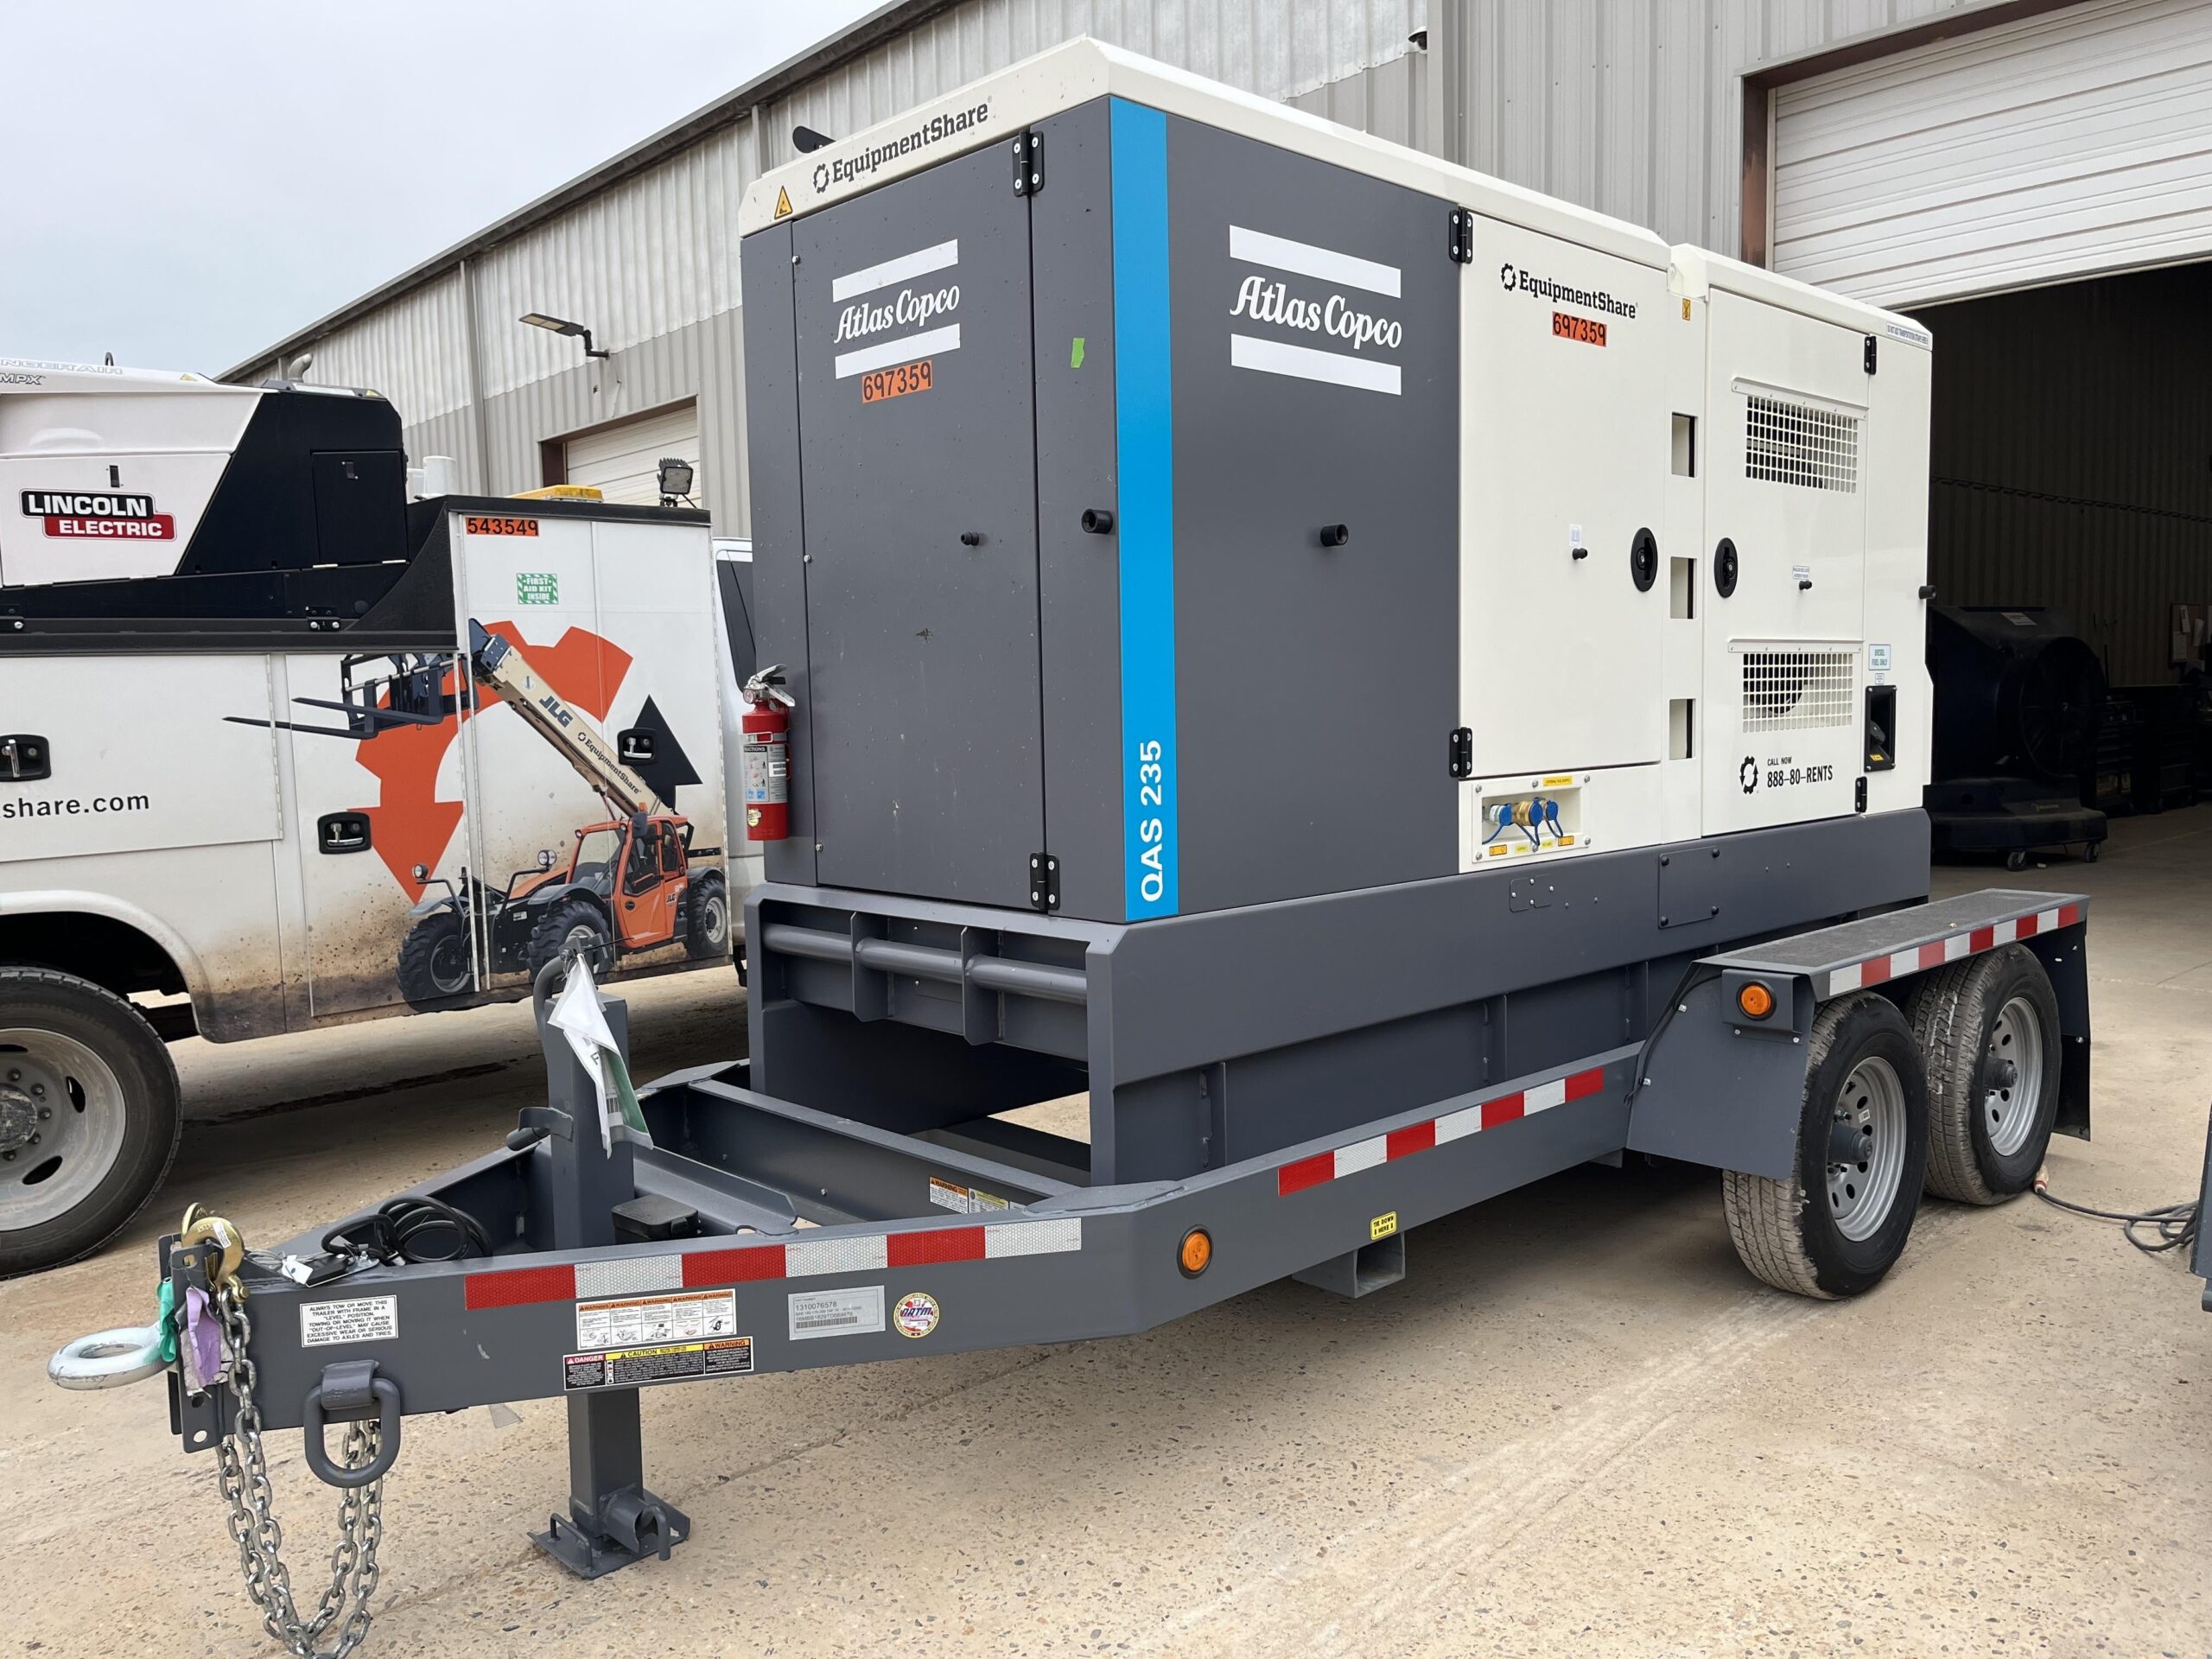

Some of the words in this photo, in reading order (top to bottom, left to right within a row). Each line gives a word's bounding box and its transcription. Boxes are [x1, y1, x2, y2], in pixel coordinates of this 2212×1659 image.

[832, 103, 988, 183] EquipmentShare
[1519, 270, 1636, 319] EquipmentShare
[834, 302, 894, 344] Atlas
[896, 285, 960, 327] Copco
[1230, 276, 1321, 332] Atlas
[1325, 295, 1402, 350] Copco
[1553, 312, 1606, 346] 697359
[863, 361, 932, 401] 697359
[28, 494, 148, 518] LINCOLN
[59, 519, 162, 537] ELECTRIC
[467, 518, 539, 536] 543549
[538, 695, 575, 728] JLG
[584, 739, 639, 795] EquipmentShare
[1140, 740, 1162, 806] 235
[1767, 758, 1779, 766] CALL
[1781, 756, 1792, 765] NOW
[1767, 765, 1833, 788] 888-80-RENTS
[3, 794, 149, 818] share.com
[1140, 817, 1163, 902] QAS
[1381, 1216, 1394, 1224] DOWN
[796, 1300, 837, 1311] 1310076578
[575, 1354, 604, 1363] DANGER
[627, 1349, 658, 1357] CAUTION
